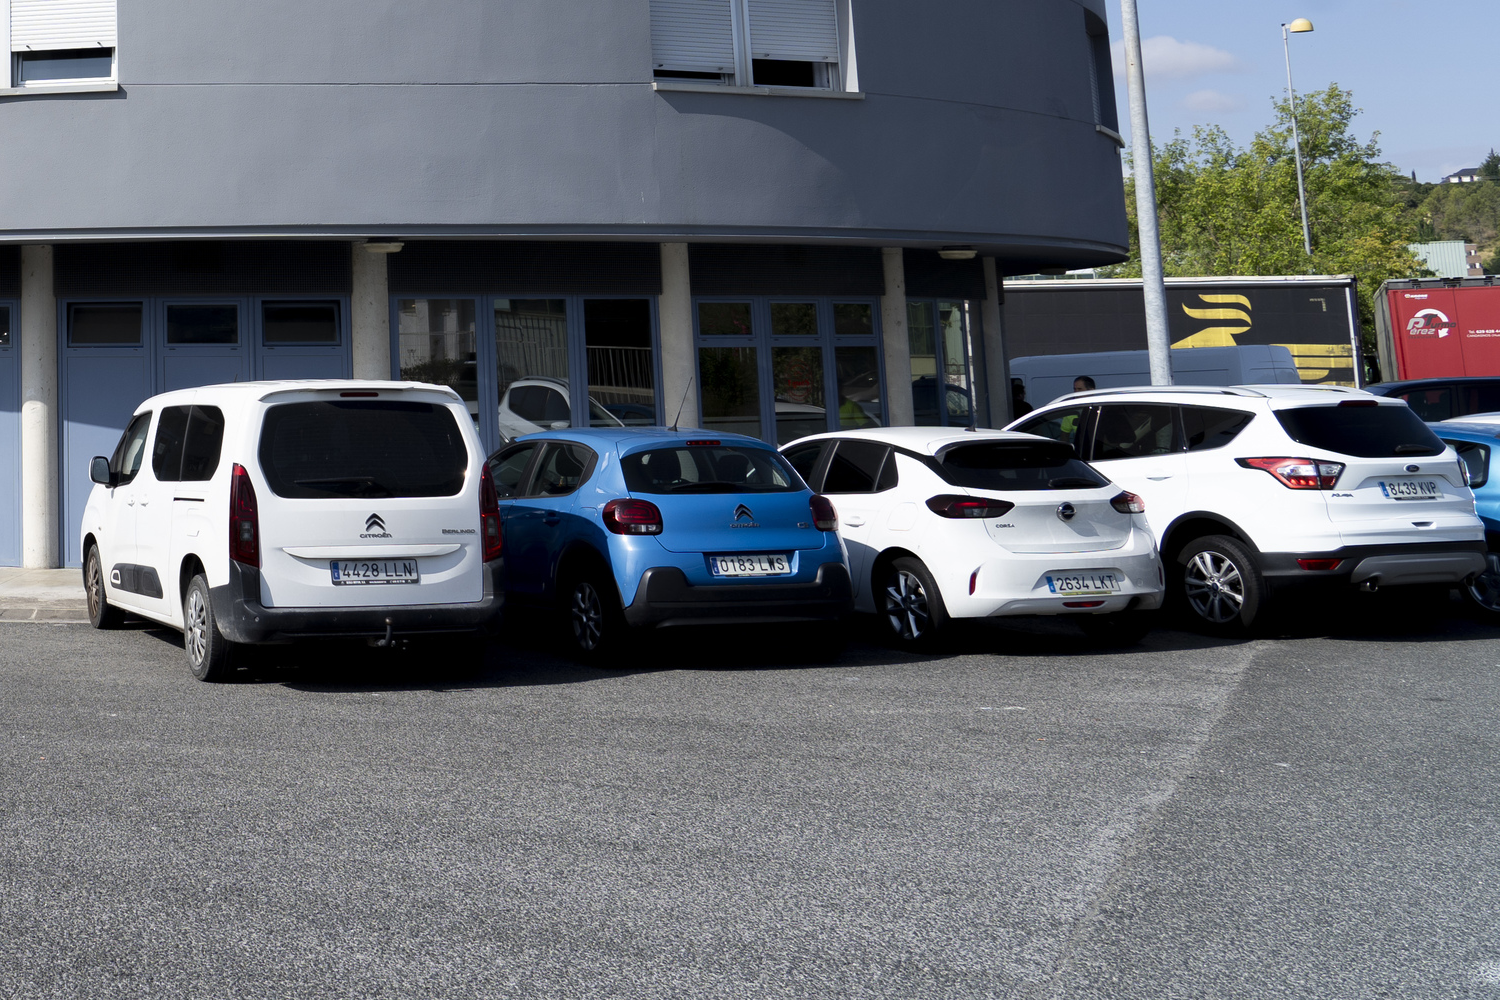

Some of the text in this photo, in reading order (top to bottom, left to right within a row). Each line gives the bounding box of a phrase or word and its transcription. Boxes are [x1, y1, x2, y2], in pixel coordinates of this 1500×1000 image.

[1388, 481, 1437, 496] 8439 KVP
[342, 562, 413, 578] 4428 LLN
[720, 557, 785, 572] 0183 LWS
[1056, 575, 1115, 591] 2634 LKT
